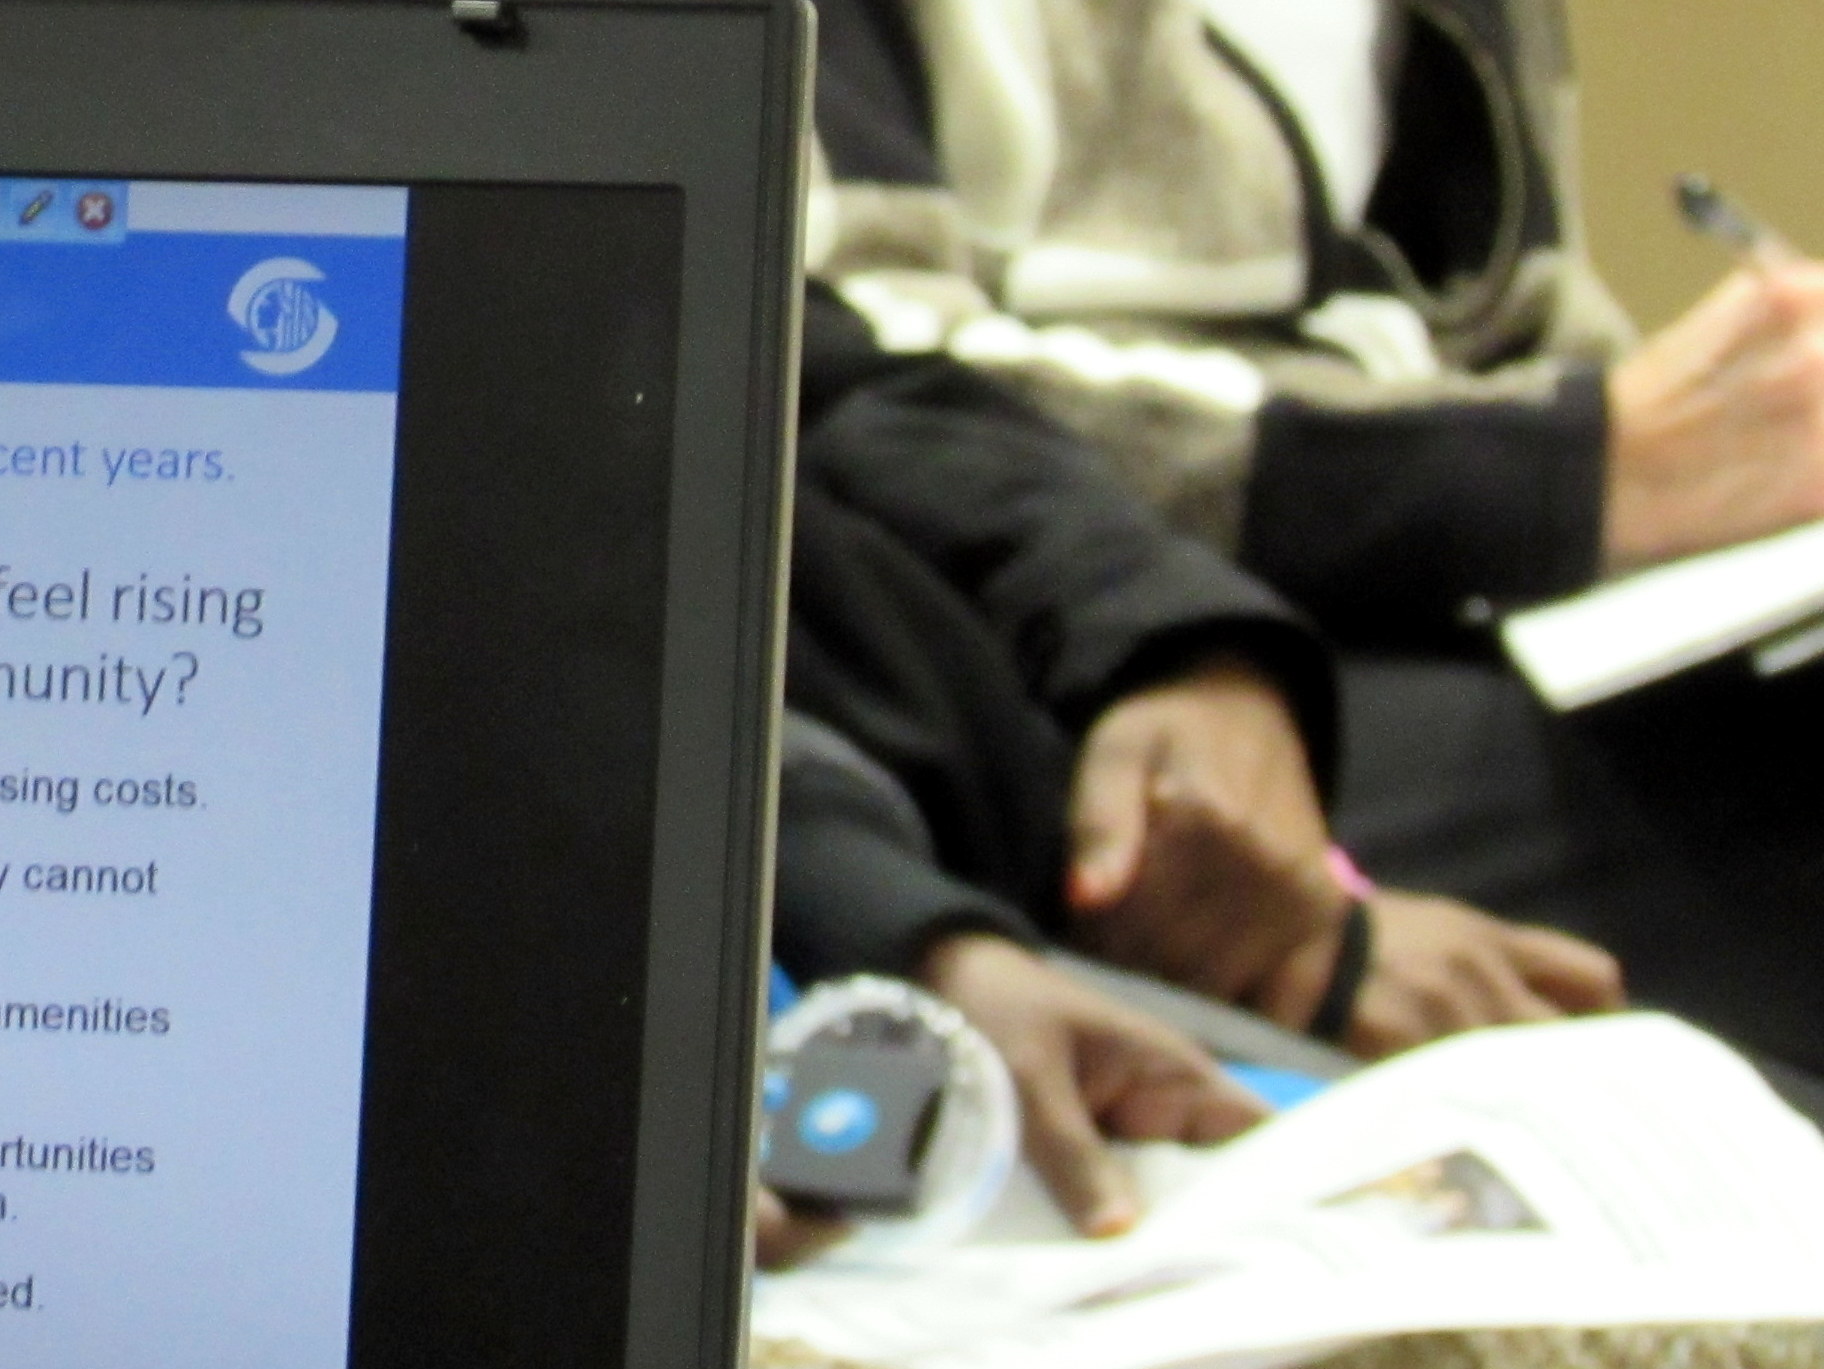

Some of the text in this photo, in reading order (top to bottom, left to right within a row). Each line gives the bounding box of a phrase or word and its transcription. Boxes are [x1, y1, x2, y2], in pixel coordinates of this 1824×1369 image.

[102, 448, 233, 487] years.
[113, 573, 263, 639] rising
[93, 774, 208, 809] costs.
[23, 861, 157, 894] cannot
